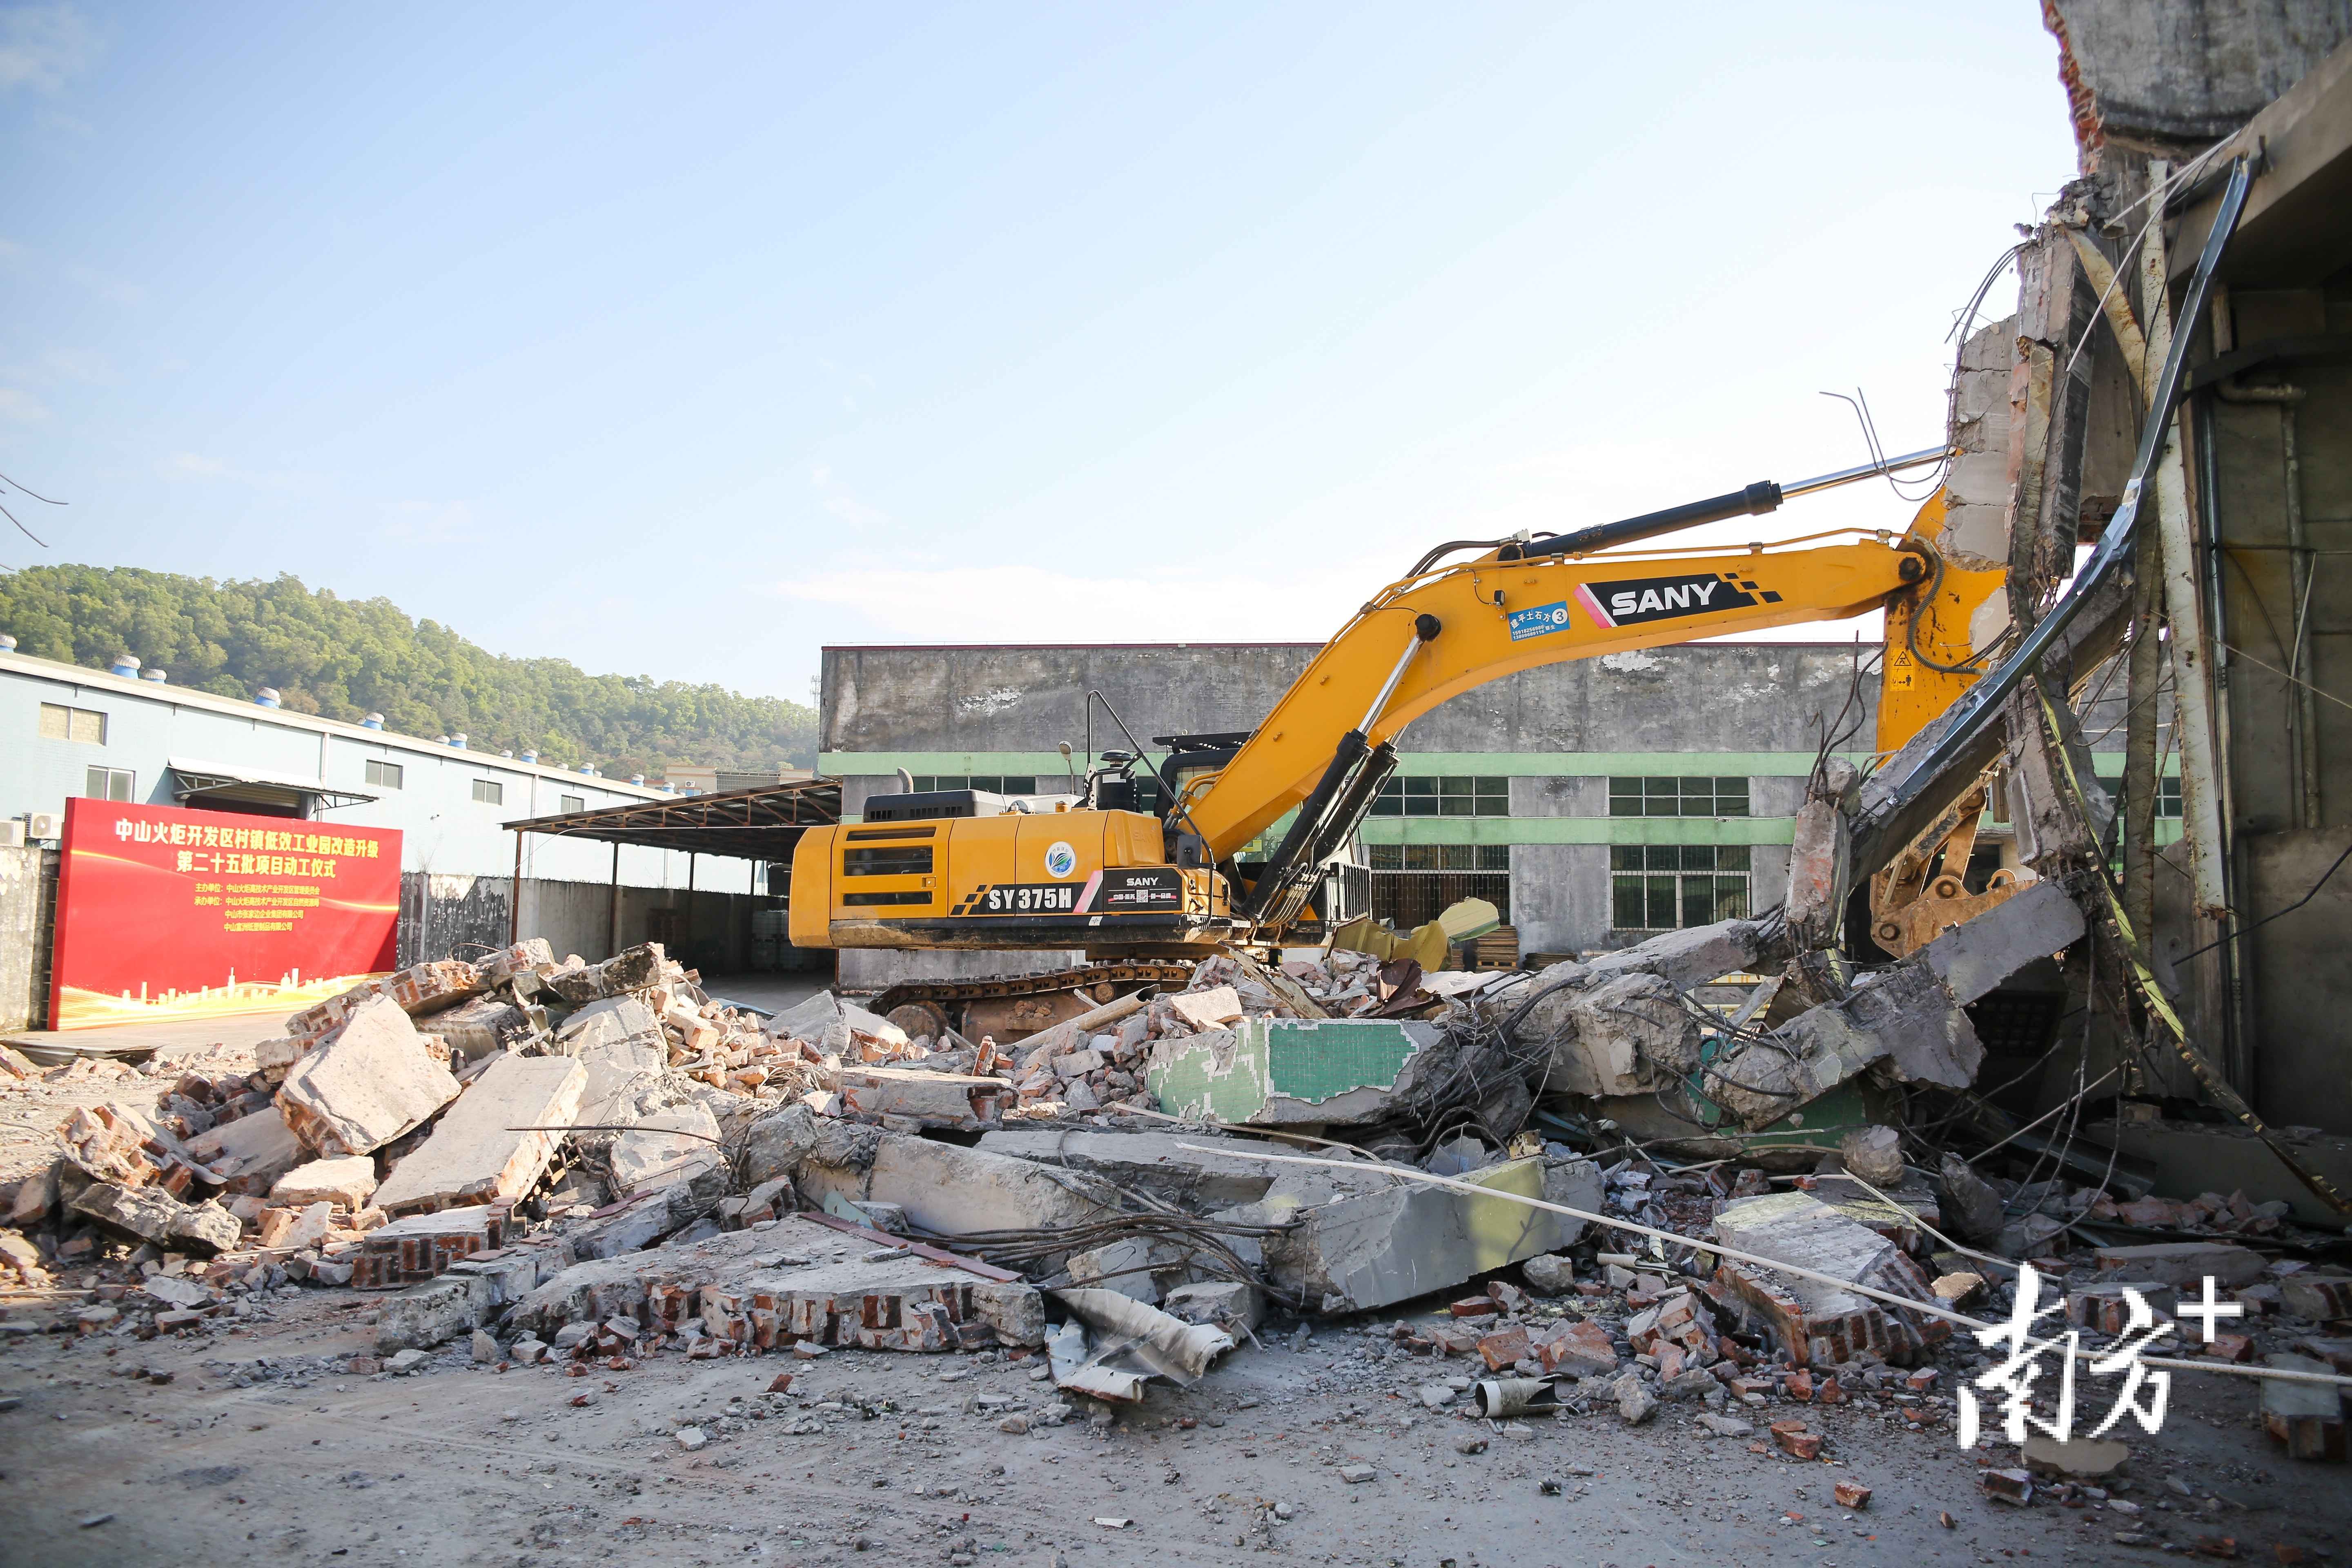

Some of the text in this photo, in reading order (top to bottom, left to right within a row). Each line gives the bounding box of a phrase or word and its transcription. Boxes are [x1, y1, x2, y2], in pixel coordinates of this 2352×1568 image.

[1611, 581, 1718, 617] SANY
[1556, 611, 1564, 621] 3
[116, 818, 379, 858] 中山火炬开发区村镇低效工业园改造升级
[176, 850, 336, 878] 第二十五批项目动工仪式
[1127, 878, 1158, 886] SANY
